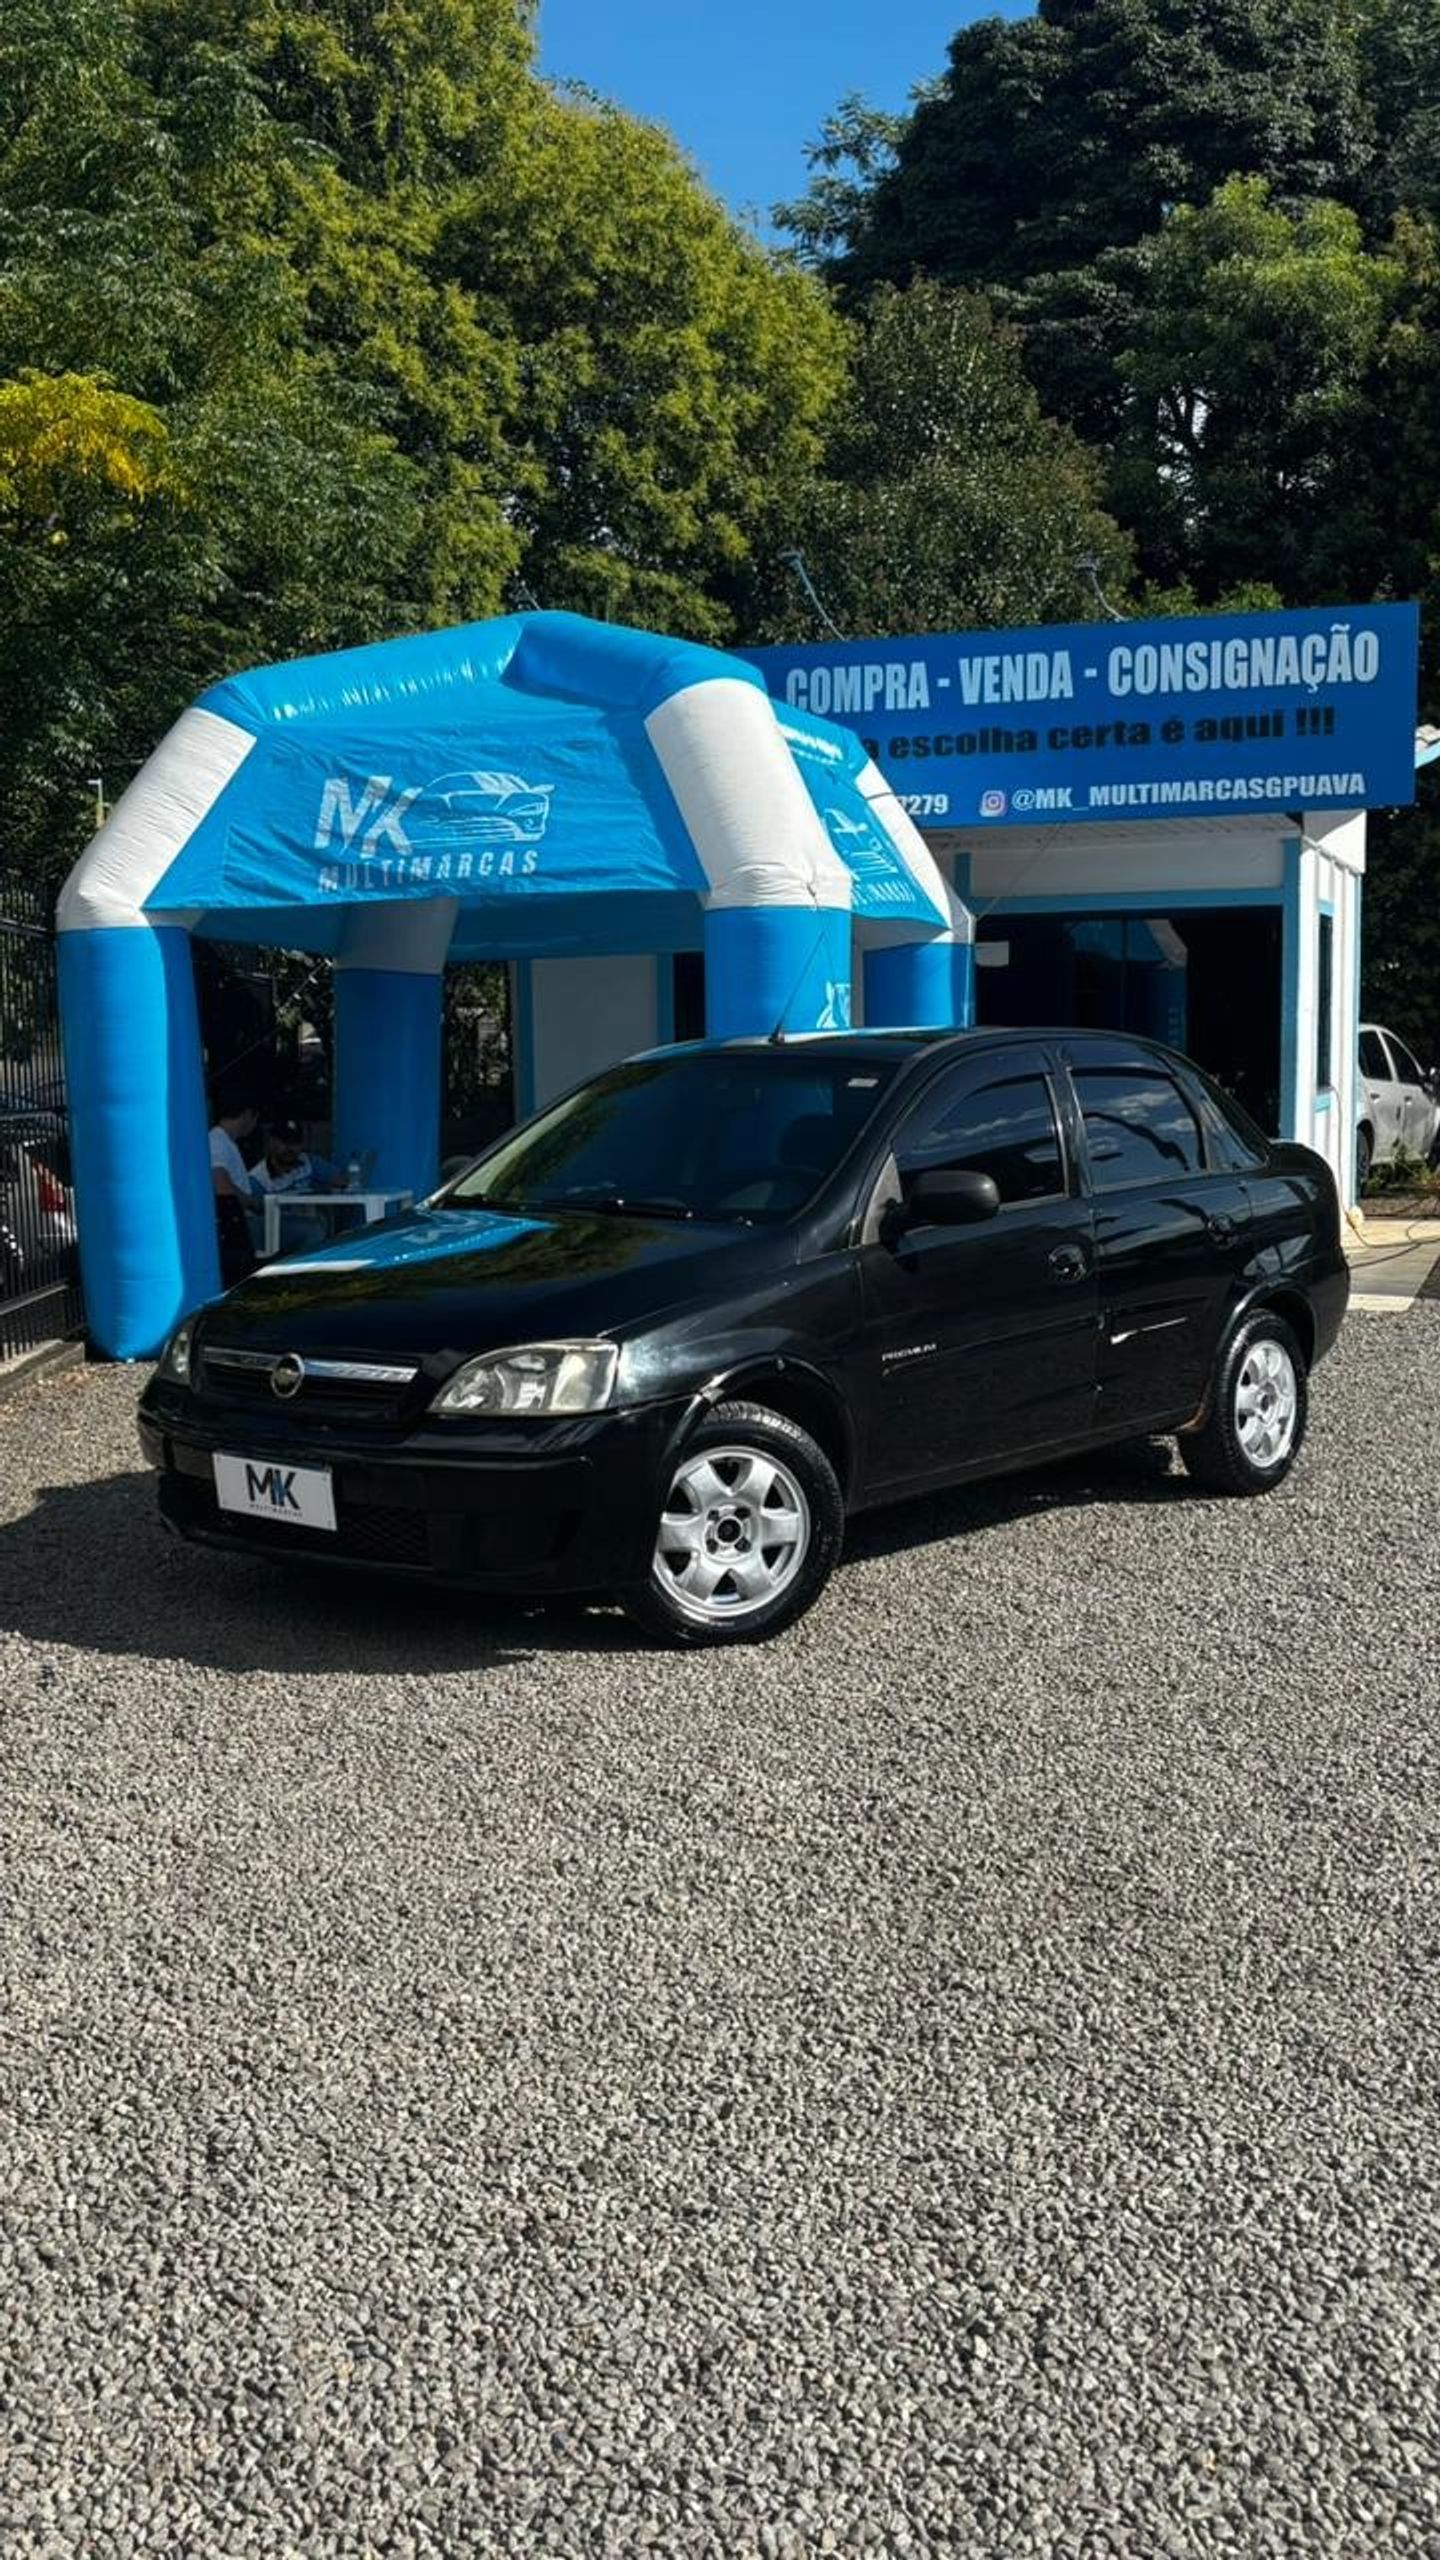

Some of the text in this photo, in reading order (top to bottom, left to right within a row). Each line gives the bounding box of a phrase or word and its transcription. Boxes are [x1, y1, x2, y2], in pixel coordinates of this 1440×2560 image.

[785, 623, 1380, 715] COMPRA - VENDA - CONSIGNAÇÃO
[888, 725, 1038, 760] escolha
[1047, 716, 1151, 750] certa
[1161, 714, 1186, 745] é
[1193, 706, 1285, 743] aqui
[1296, 705, 1335, 737] !!!
[313, 774, 424, 859] MK
[1011, 773, 1368, 813] @MK_MULTIMARCASGPUAVA
[317, 850, 539, 894] MULTIMARCAS
[245, 1463, 301, 1510] MK
